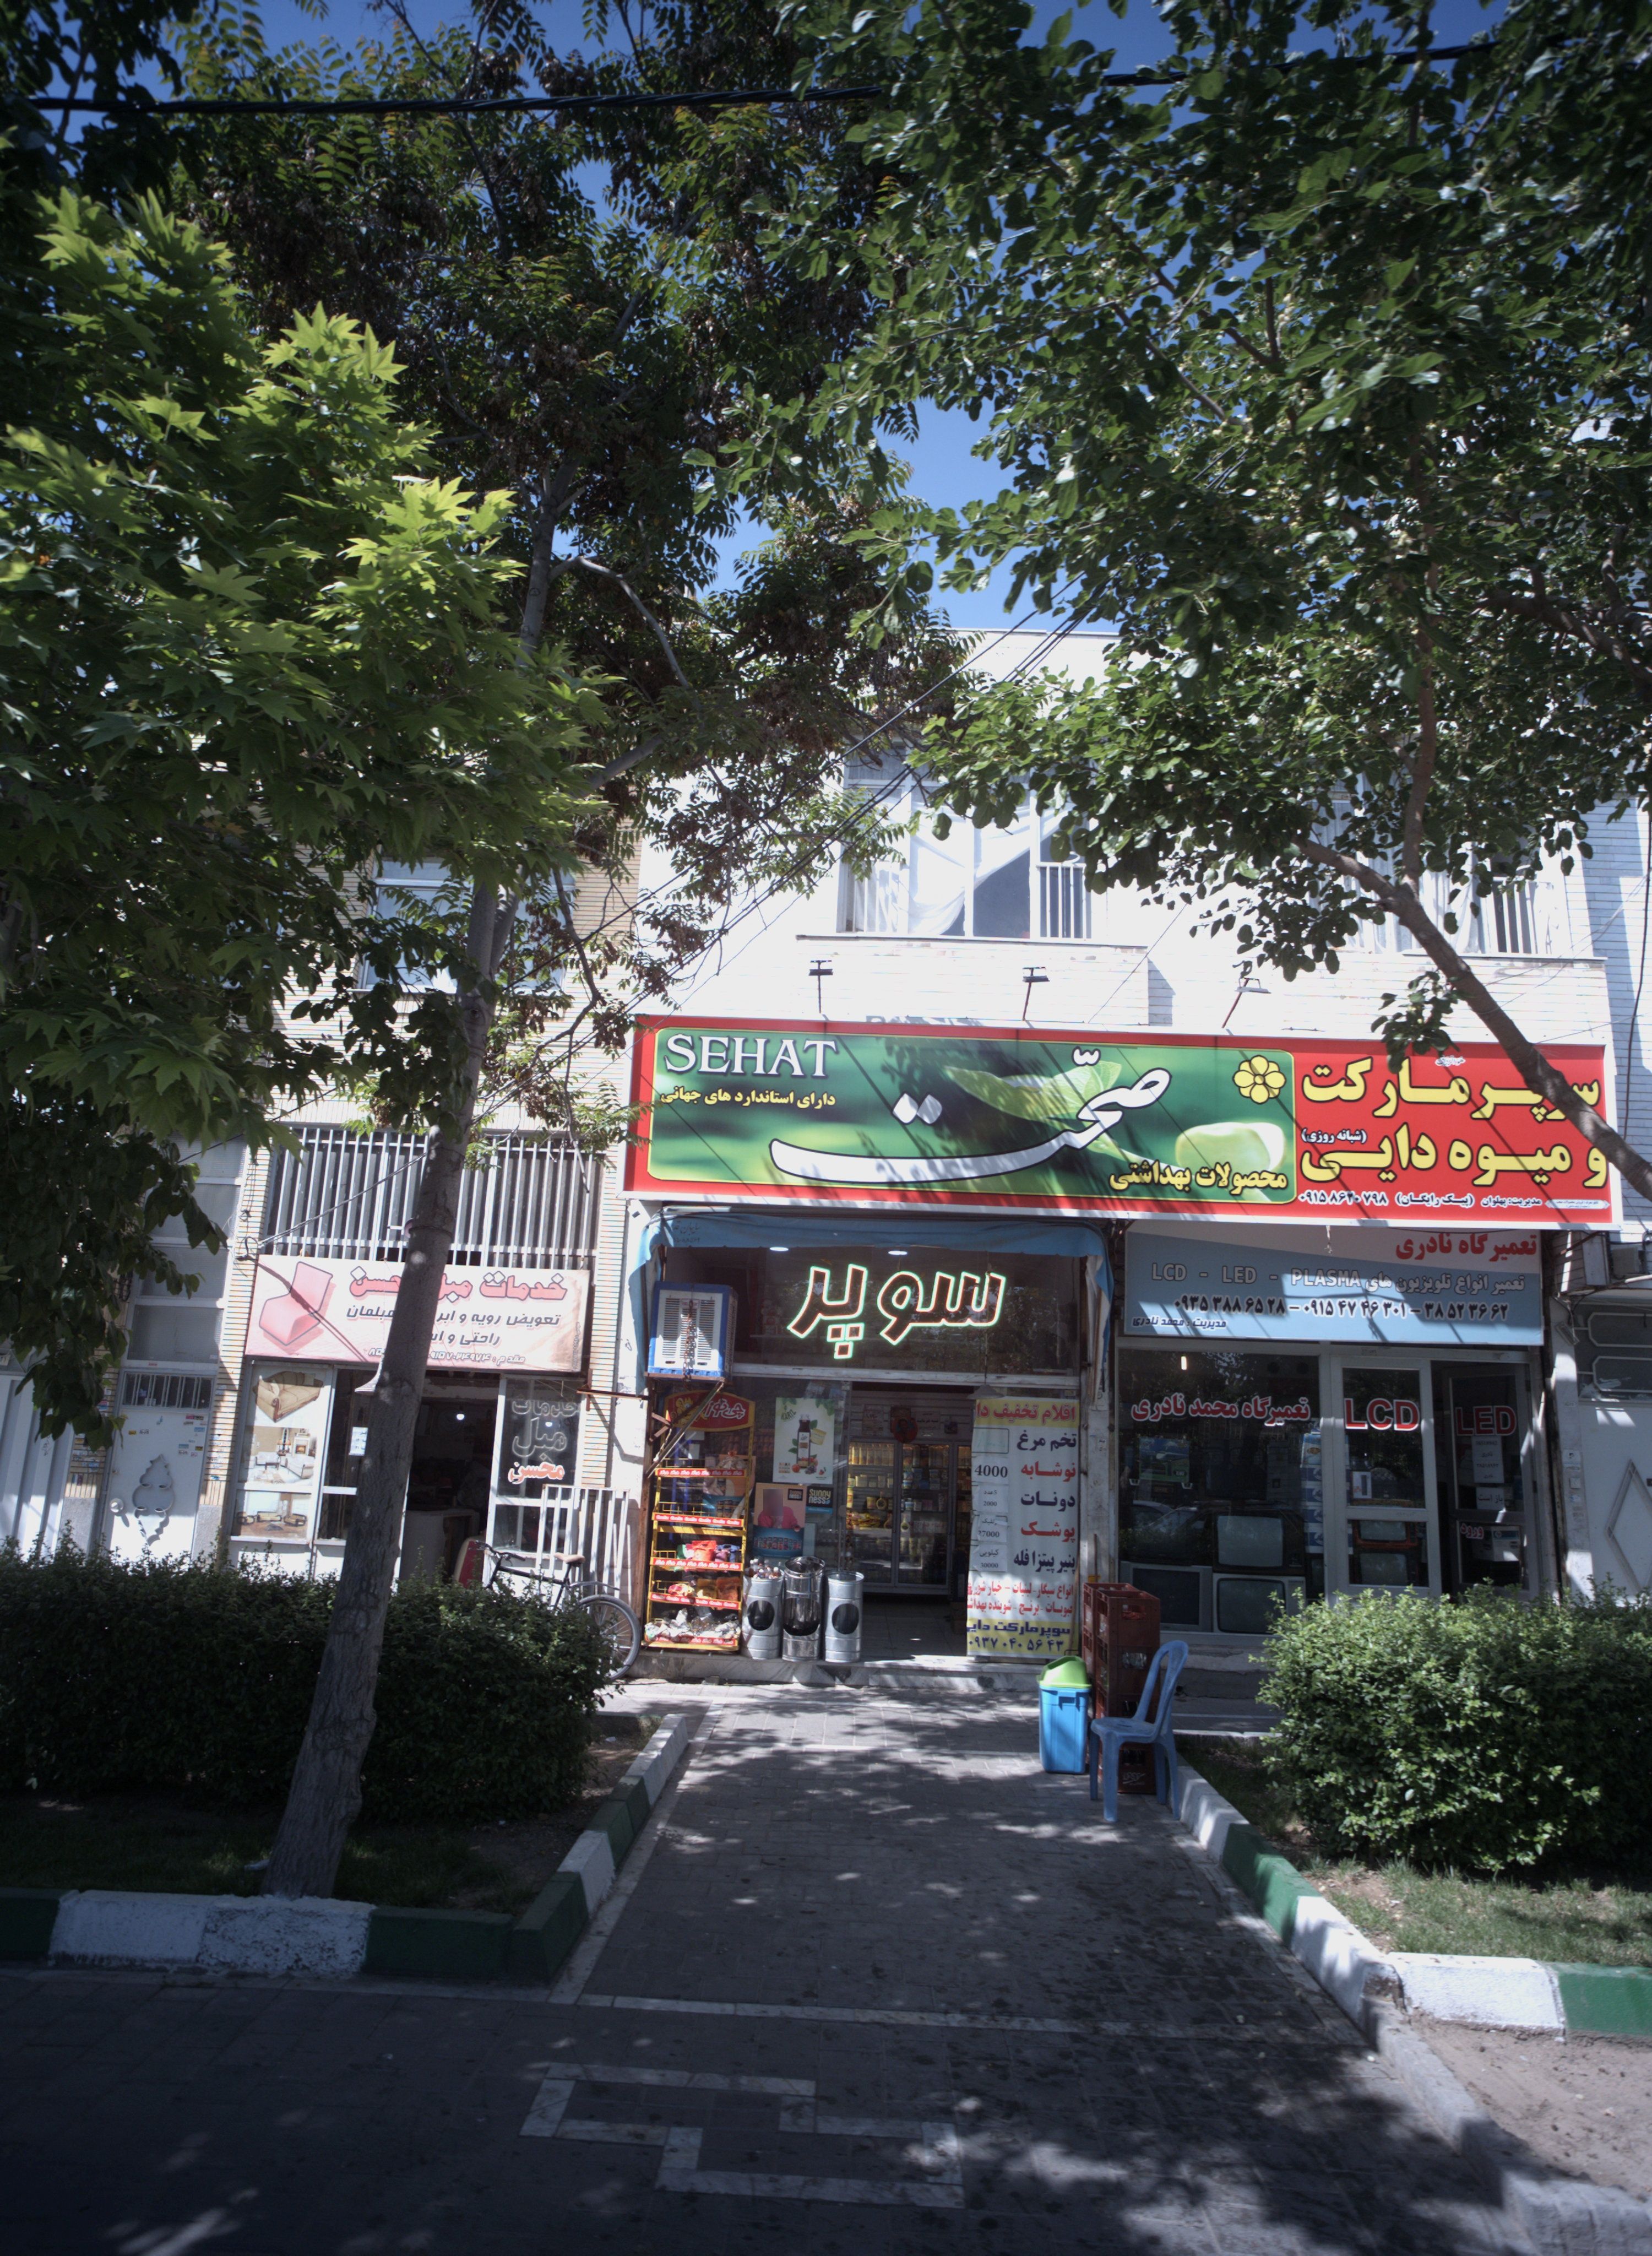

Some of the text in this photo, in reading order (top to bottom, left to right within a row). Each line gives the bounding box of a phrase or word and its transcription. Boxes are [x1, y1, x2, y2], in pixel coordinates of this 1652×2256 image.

[664, 1034, 839, 1078] SEHAT
[660, 1085, 836, 1109] دارای استاندارد های جهانی
[1300, 1122, 1608, 1188] و میوه دایی
[1109, 1159, 1288, 1196] محصولات بهداشتی
[1396, 1233, 1453, 1261] نادری
[349, 1266, 401, 1297] حسن
[1151, 1263, 1187, 1282] LCD
[1221, 1266, 1257, 1284] LED
[1291, 1268, 1362, 1288] PLASMA
[1365, 1271, 1392, 1292] های
[479, 1271, 568, 1301] خدمات
[1395, 1273, 1452, 1294] تلویزیون
[1454, 1274, 1488, 1296] انواع
[1490, 1275, 1525, 1295] تعمیر
[436, 1310, 455, 1324] ابر
[459, 1313, 467, 1324] و
[471, 1313, 501, 1326] رویه
[506, 1313, 561, 1328] تعویض
[788, 1263, 1007, 1359] سوپر
[1132, 1316, 1160, 1327] نادری
[1161, 1317, 1185, 1327] محمد
[1193, 1317, 1226, 1329] مدیریت
[447, 1333, 456, 1344] و
[459, 1332, 501, 1346] راحتی
[993, 1403, 1039, 1423] تخفیف
[1042, 1404, 1076, 1425] اقلام
[1131, 1392, 1186, 1422] نادری
[1188, 1398, 1238, 1418] محمد
[1344, 1397, 1420, 1431] LCD
[1455, 1405, 1517, 1436] LED
[512, 1417, 568, 1461] مبل
[1017, 1429, 1046, 1451] مرغ
[1050, 1432, 1077, 1451] تخم
[508, 1461, 566, 1485] محسن
[974, 1464, 1008, 1478] 4000
[1020, 1461, 1077, 1483] نوشابه
[808, 1496, 827, 1505] ness
[809, 1488, 832, 1499] Sunny
[1020, 1490, 1076, 1512] دونات
[1020, 1521, 1076, 1542] پوشک
[1460, 1522, 1484, 1540] ورود
[1013, 1548, 1076, 1574] پنیر پیتزا فله
[1012, 1581, 1032, 1597] لبنیات
[1057, 1583, 1074, 1599] انواع
[967, 1598, 987, 1613] بهداش
[1019, 1599, 1040, 1615] برنج
